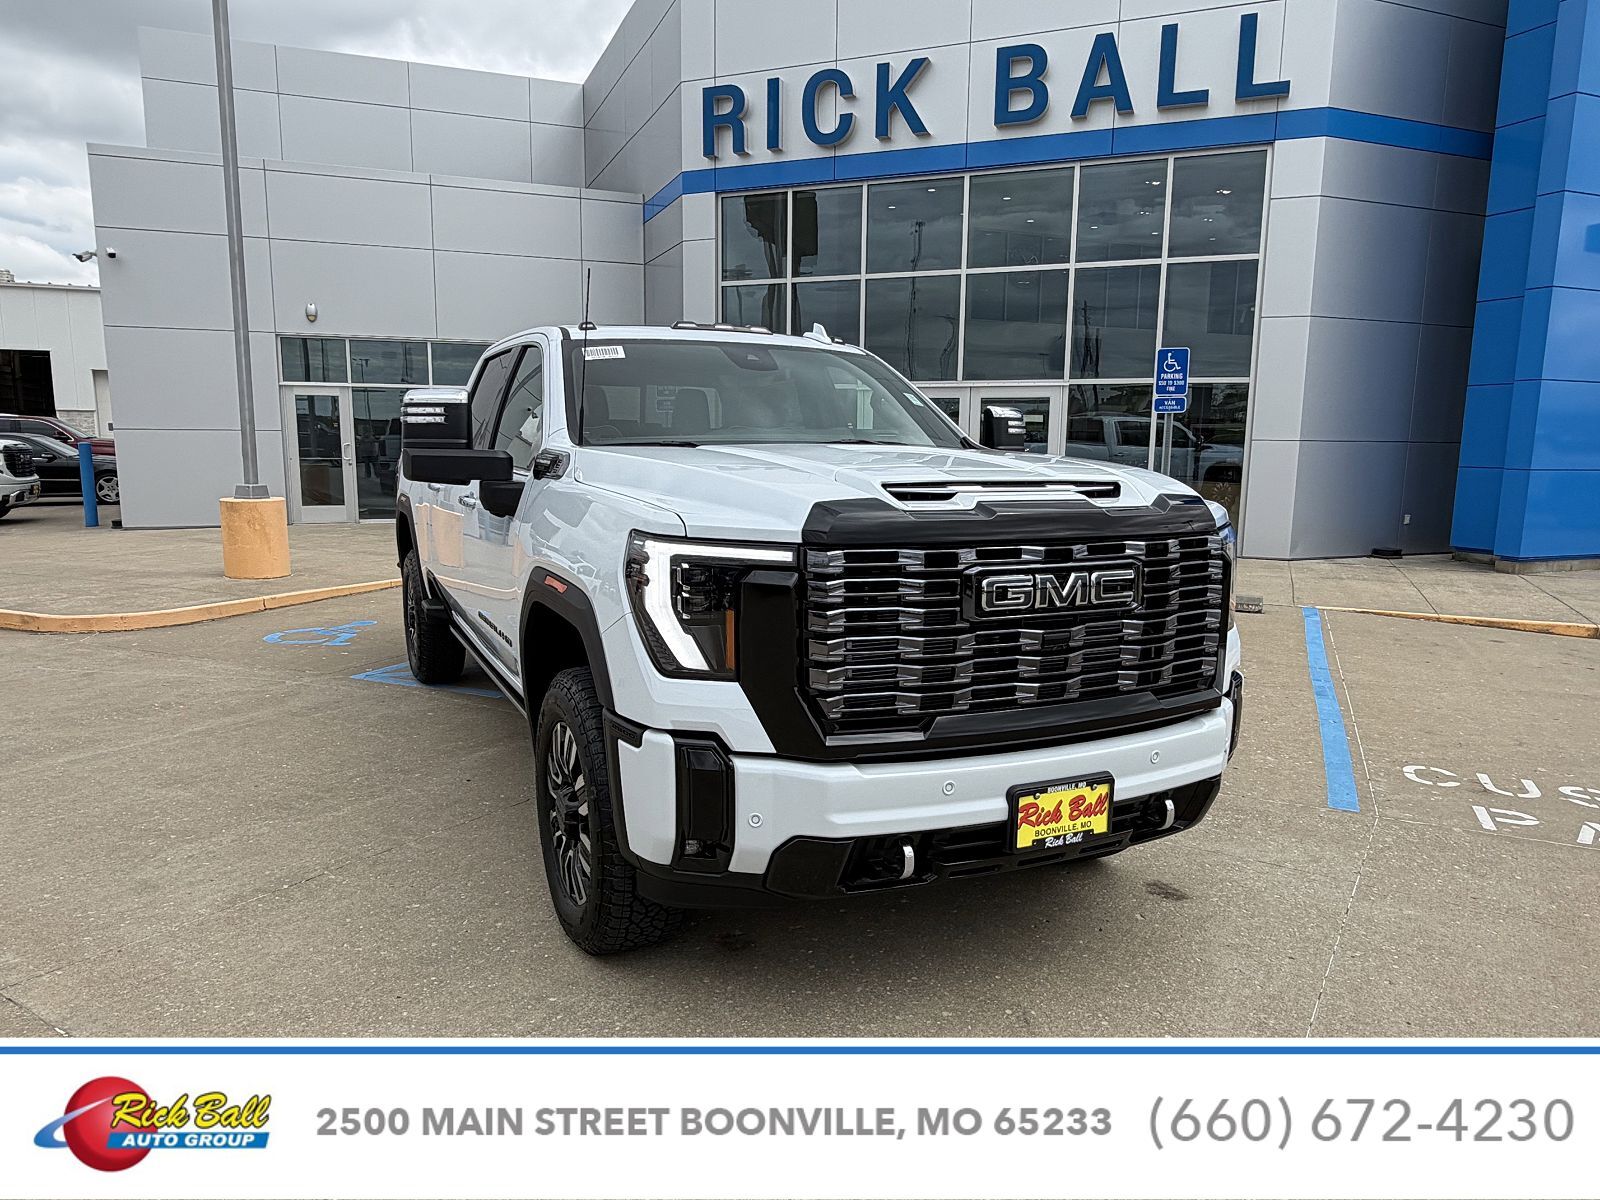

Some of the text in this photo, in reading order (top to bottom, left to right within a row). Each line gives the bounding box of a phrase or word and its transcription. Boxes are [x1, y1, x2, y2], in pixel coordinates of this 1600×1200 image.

[701, 12, 1292, 160] RICK BALL
[981, 570, 1136, 612] GMC
[1078, 781, 1087, 789] MO
[1018, 791, 1109, 830] Rick Ball
[1034, 820, 1092, 837] BOONVILLE, MO
[1044, 832, 1084, 849] Rick Ball
